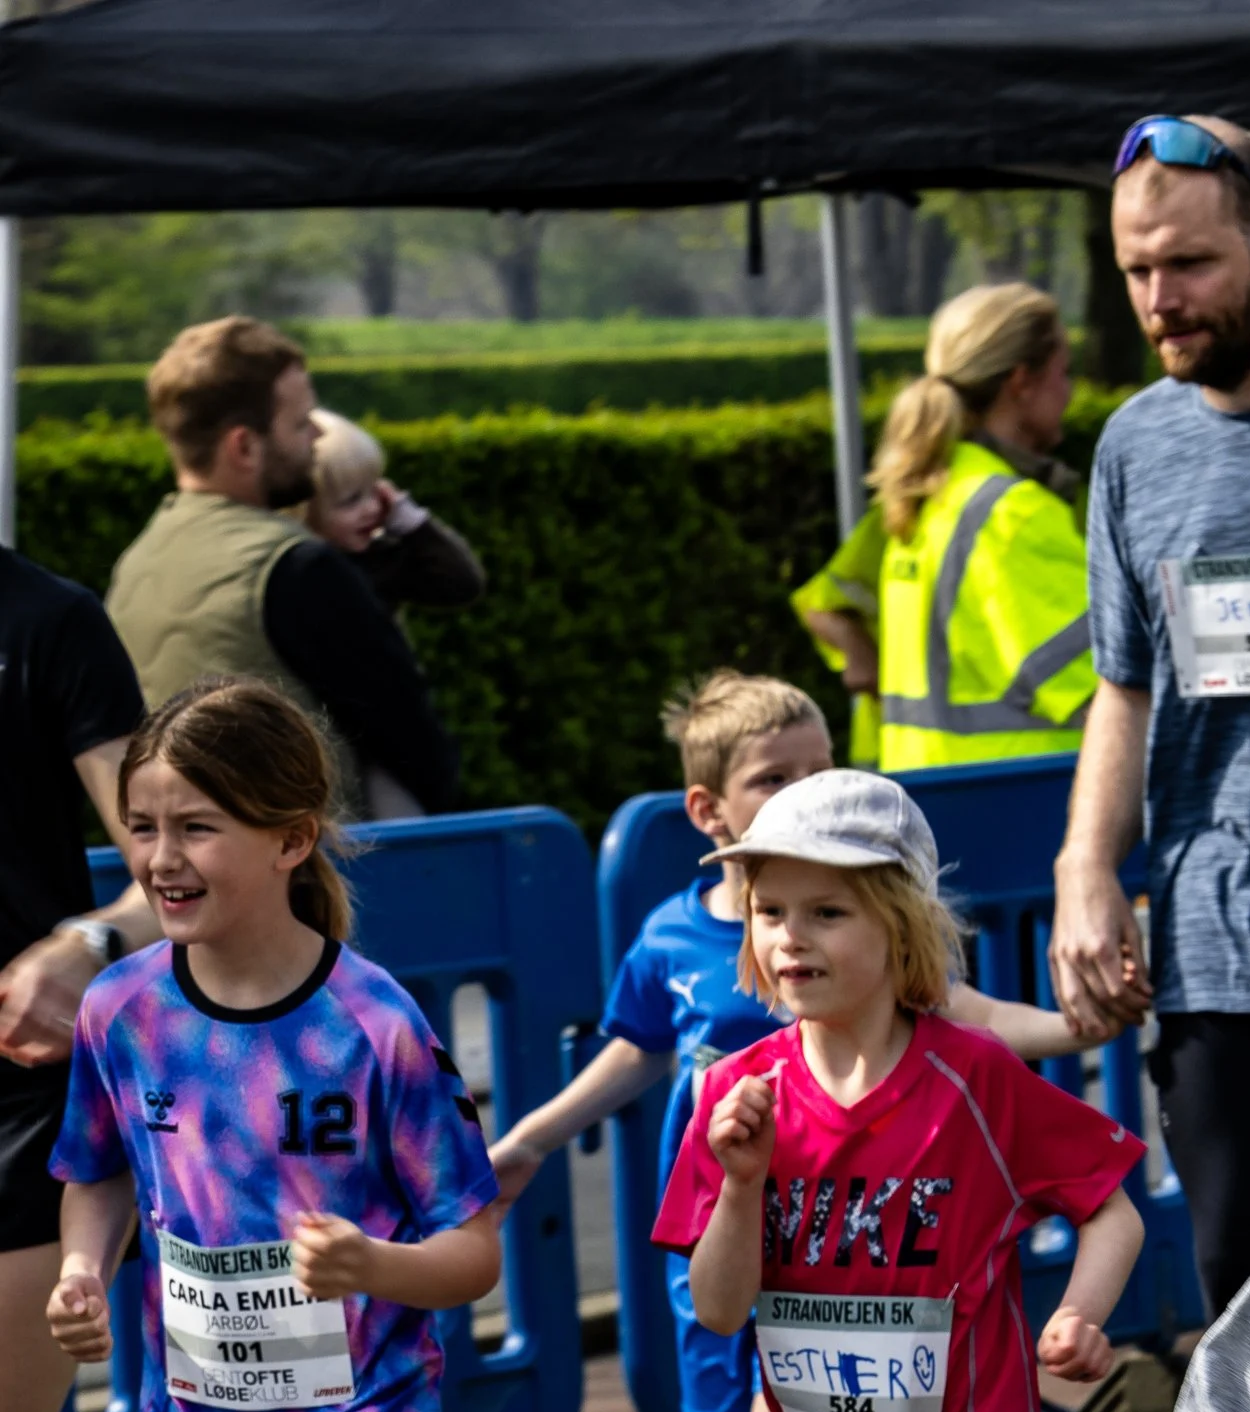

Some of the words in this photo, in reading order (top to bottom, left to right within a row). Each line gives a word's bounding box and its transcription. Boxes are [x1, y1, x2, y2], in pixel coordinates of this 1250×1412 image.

[277, 1090, 357, 1155] 12
[764, 1176, 954, 1268] NIKE
[169, 1240, 262, 1275] STRANDVEJEN
[267, 1245, 291, 1268] 5K
[168, 1278, 229, 1312] CARLA
[237, 1286, 331, 1311] EMIL
[205, 1314, 270, 1332] JARBØL
[771, 1297, 886, 1324] STRANDVEJEN
[891, 1302, 915, 1325] 5K
[217, 1341, 264, 1363] 101
[201, 1368, 296, 1386] GENTOFTE
[768, 1349, 910, 1401] ESTHER
[204, 1385, 299, 1403] LØBEKLUB
